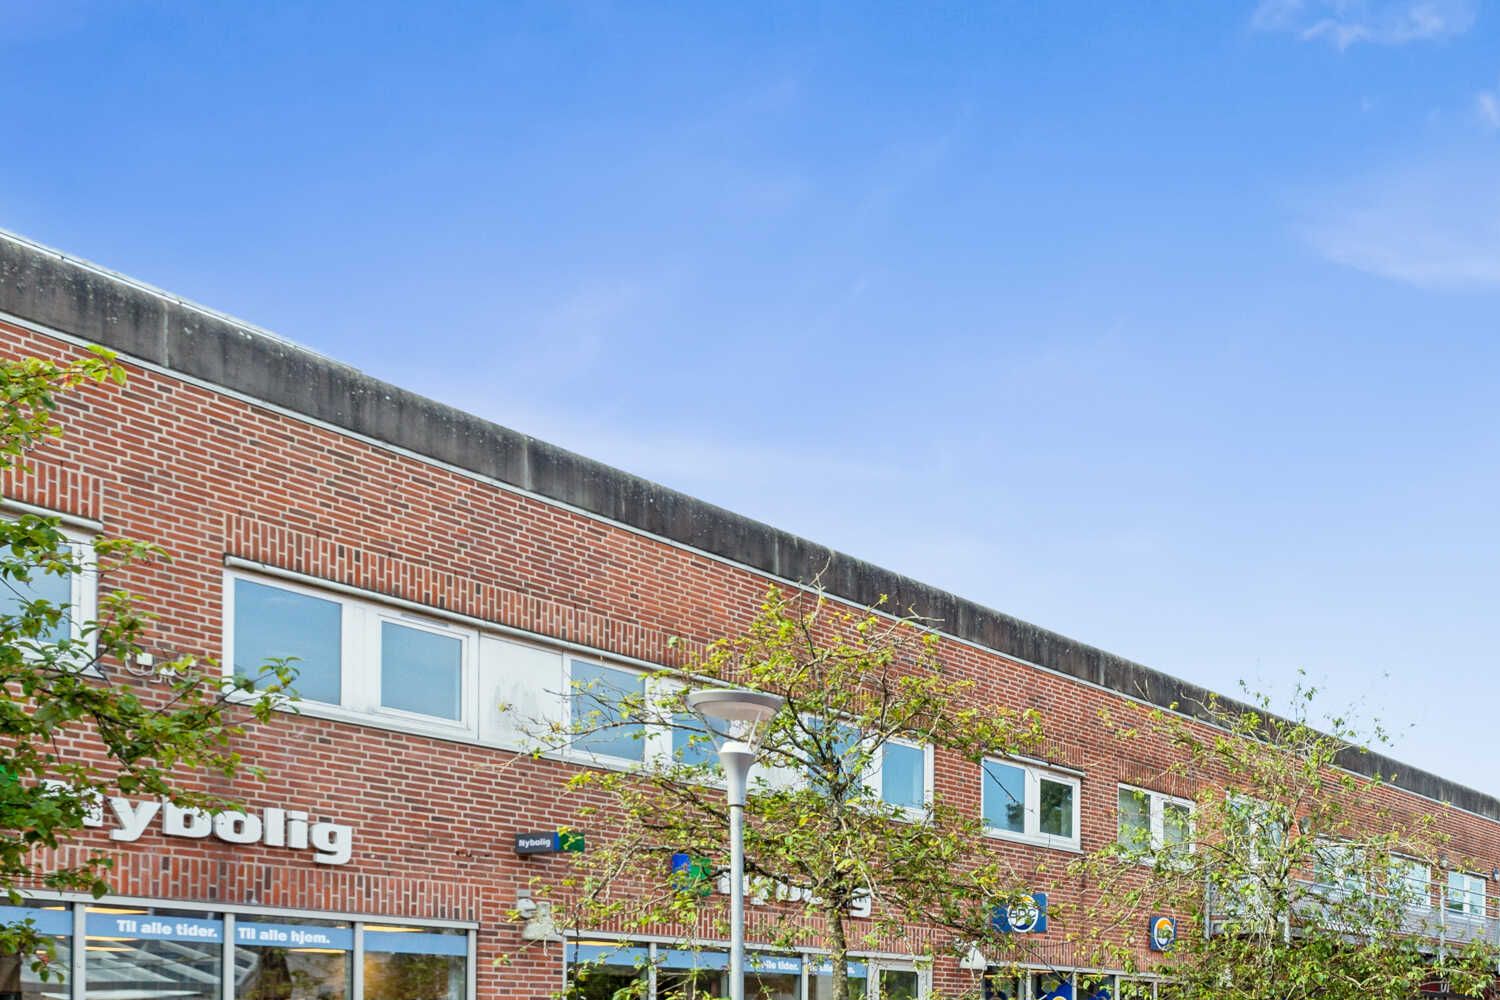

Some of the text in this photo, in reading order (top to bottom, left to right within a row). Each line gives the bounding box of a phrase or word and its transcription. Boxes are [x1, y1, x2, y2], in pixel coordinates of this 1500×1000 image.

[518, 838, 551, 849] Nybolig
[116, 919, 219, 938] Til alle tider.
[237, 927, 331, 946] Til alle hjem.
